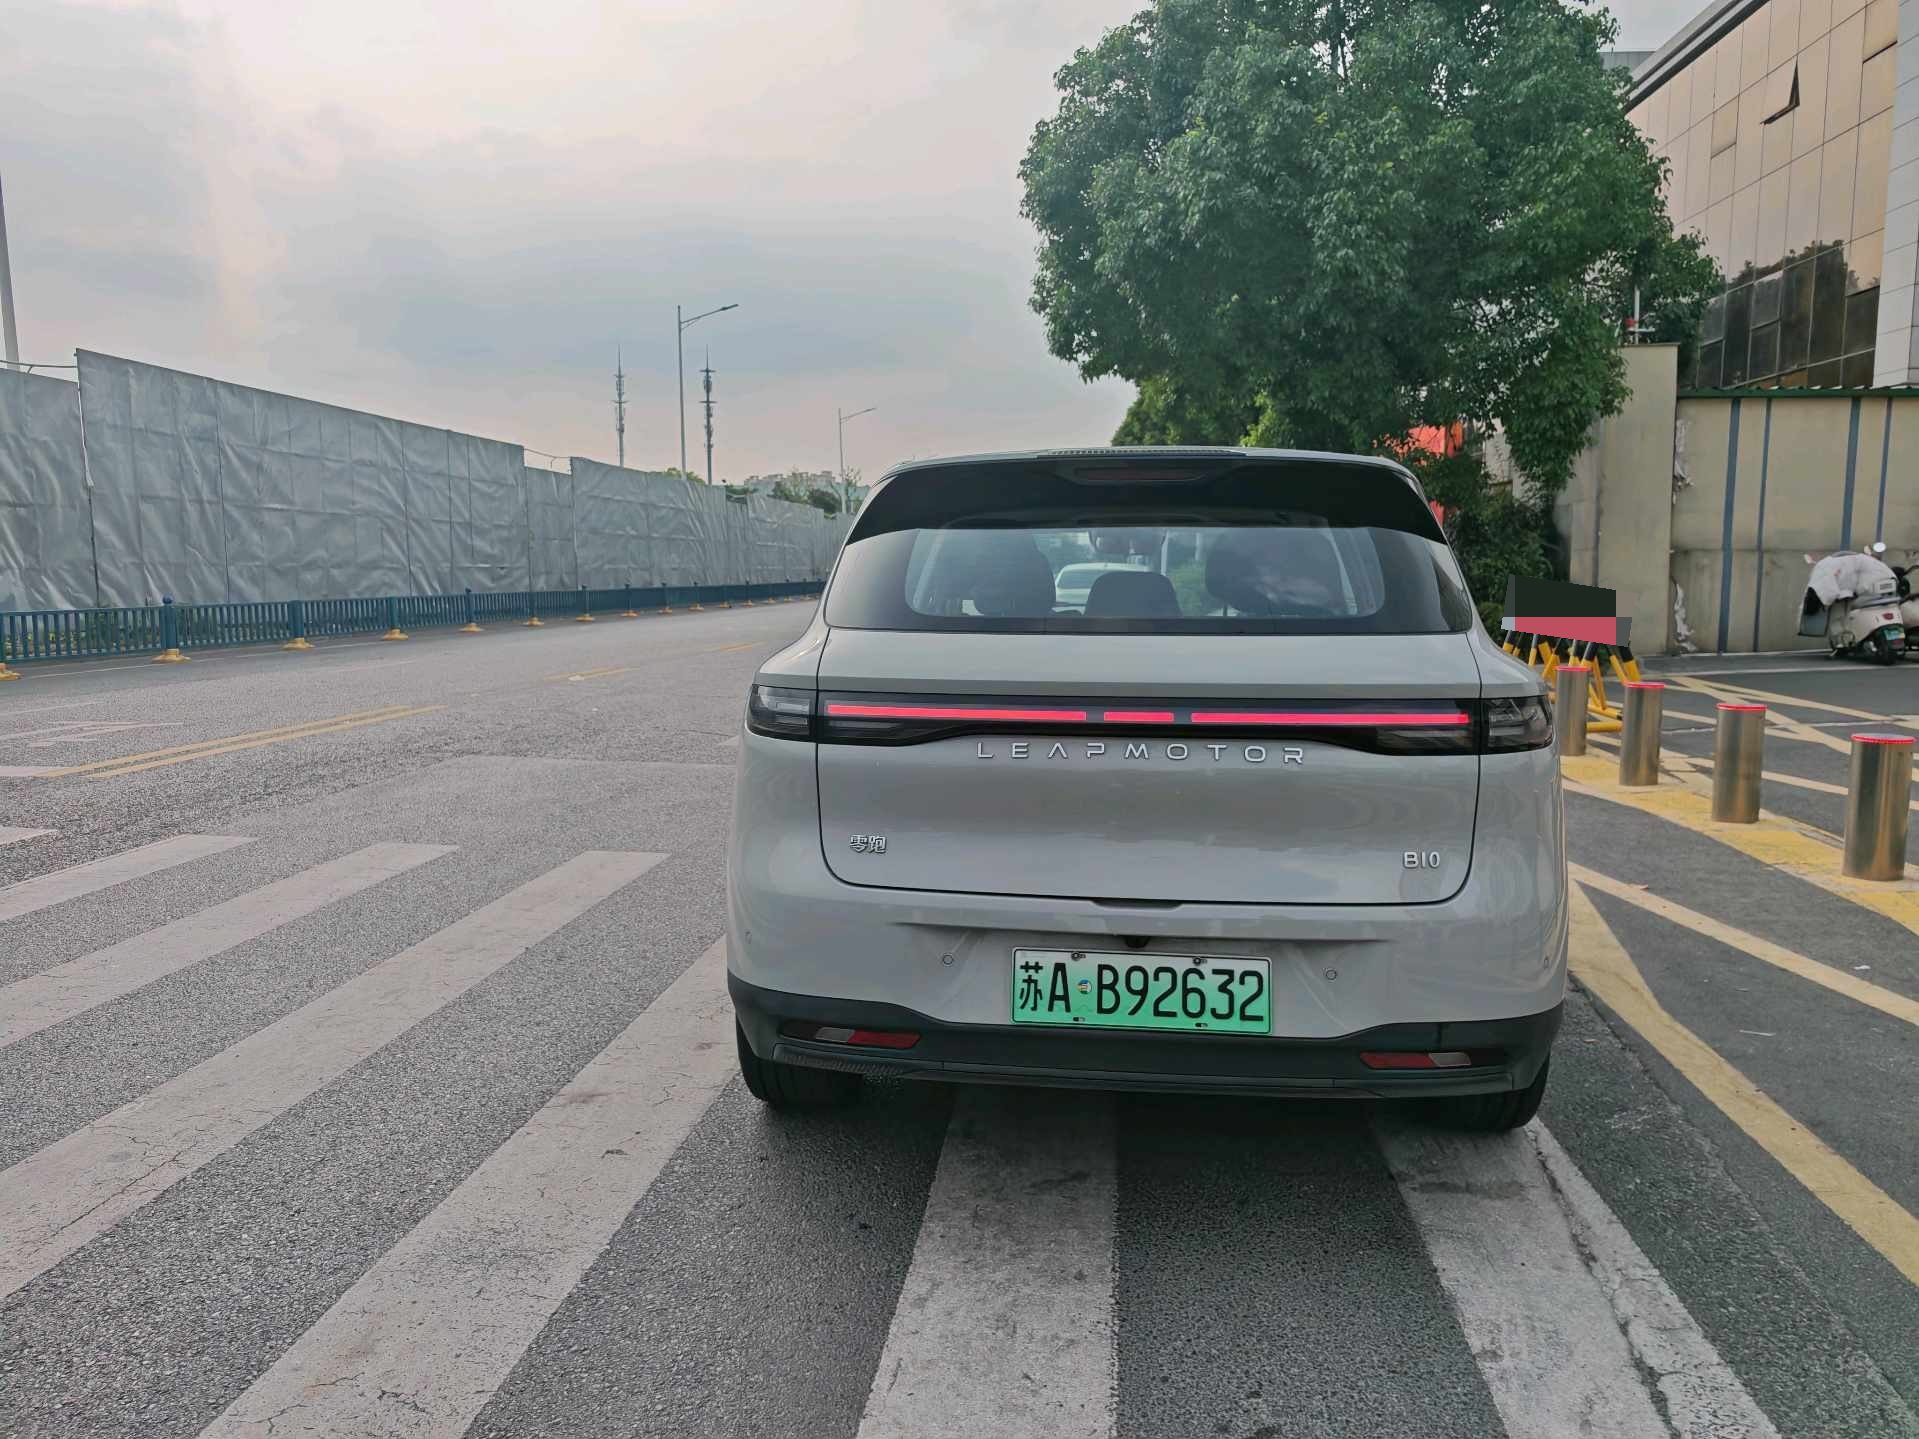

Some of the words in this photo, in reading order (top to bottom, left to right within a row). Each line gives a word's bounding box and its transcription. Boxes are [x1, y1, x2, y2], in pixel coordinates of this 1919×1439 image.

[977, 742, 1304, 764] LEAPMOTOR
[849, 834, 887, 854] 零跑
[1403, 850, 1441, 869] B10
